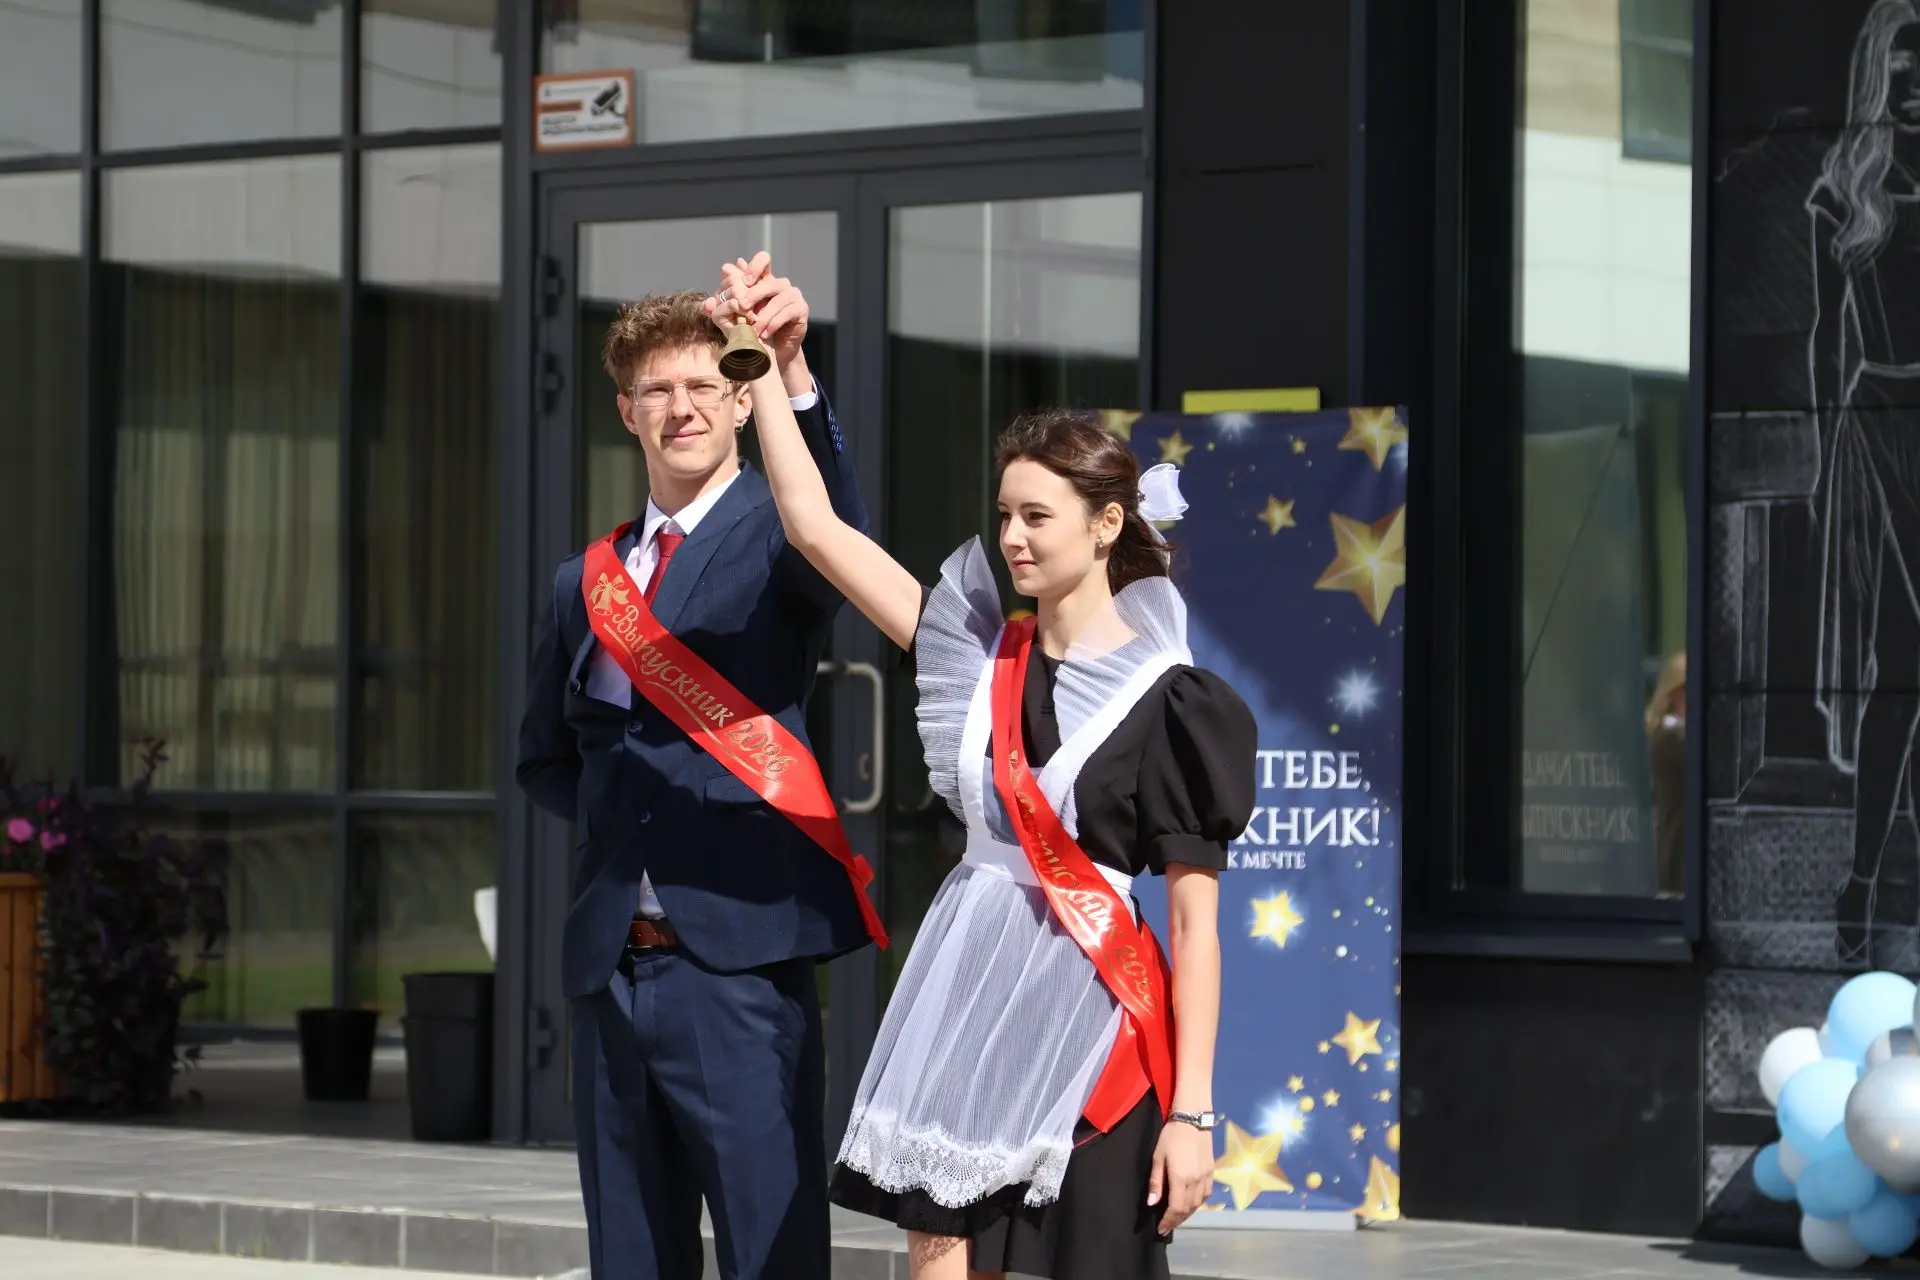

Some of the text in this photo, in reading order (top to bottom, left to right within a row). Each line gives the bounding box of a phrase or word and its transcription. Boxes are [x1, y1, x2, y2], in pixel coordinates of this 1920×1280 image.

[1256, 750, 1371, 792] ТЕБЕ,
[1227, 850, 1307, 869] К МЕЧТЕ
